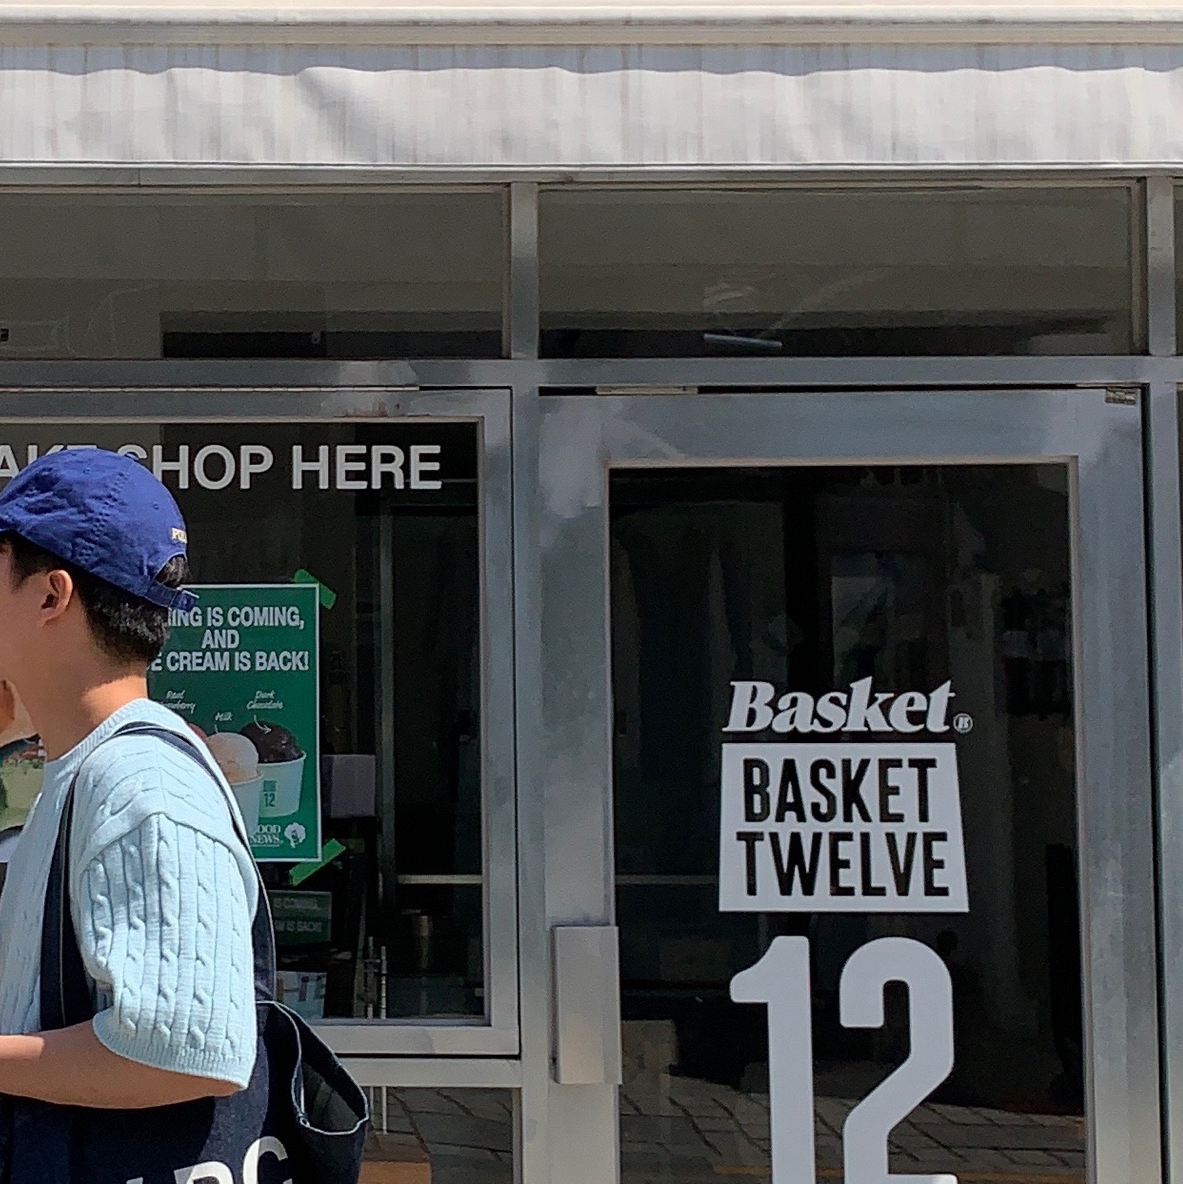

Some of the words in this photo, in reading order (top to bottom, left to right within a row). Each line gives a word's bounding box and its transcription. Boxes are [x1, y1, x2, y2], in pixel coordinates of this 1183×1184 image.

[117, 444, 274, 490] HOP
[292, 444, 443, 491] HERE
[168, 606, 202, 627] ING
[207, 607, 224, 627] IS
[227, 606, 304, 630] COMING,
[201, 629, 240, 649] AND
[166, 651, 230, 672] CREAM
[234, 651, 251, 671] IS
[255, 651, 309, 671] BACK!
[721, 676, 956, 733] Basket
[263, 793, 275, 807] 12
[743, 757, 938, 824] BASKET
[254, 824, 281, 834] OOD
[736, 831, 950, 898] TWELVE
